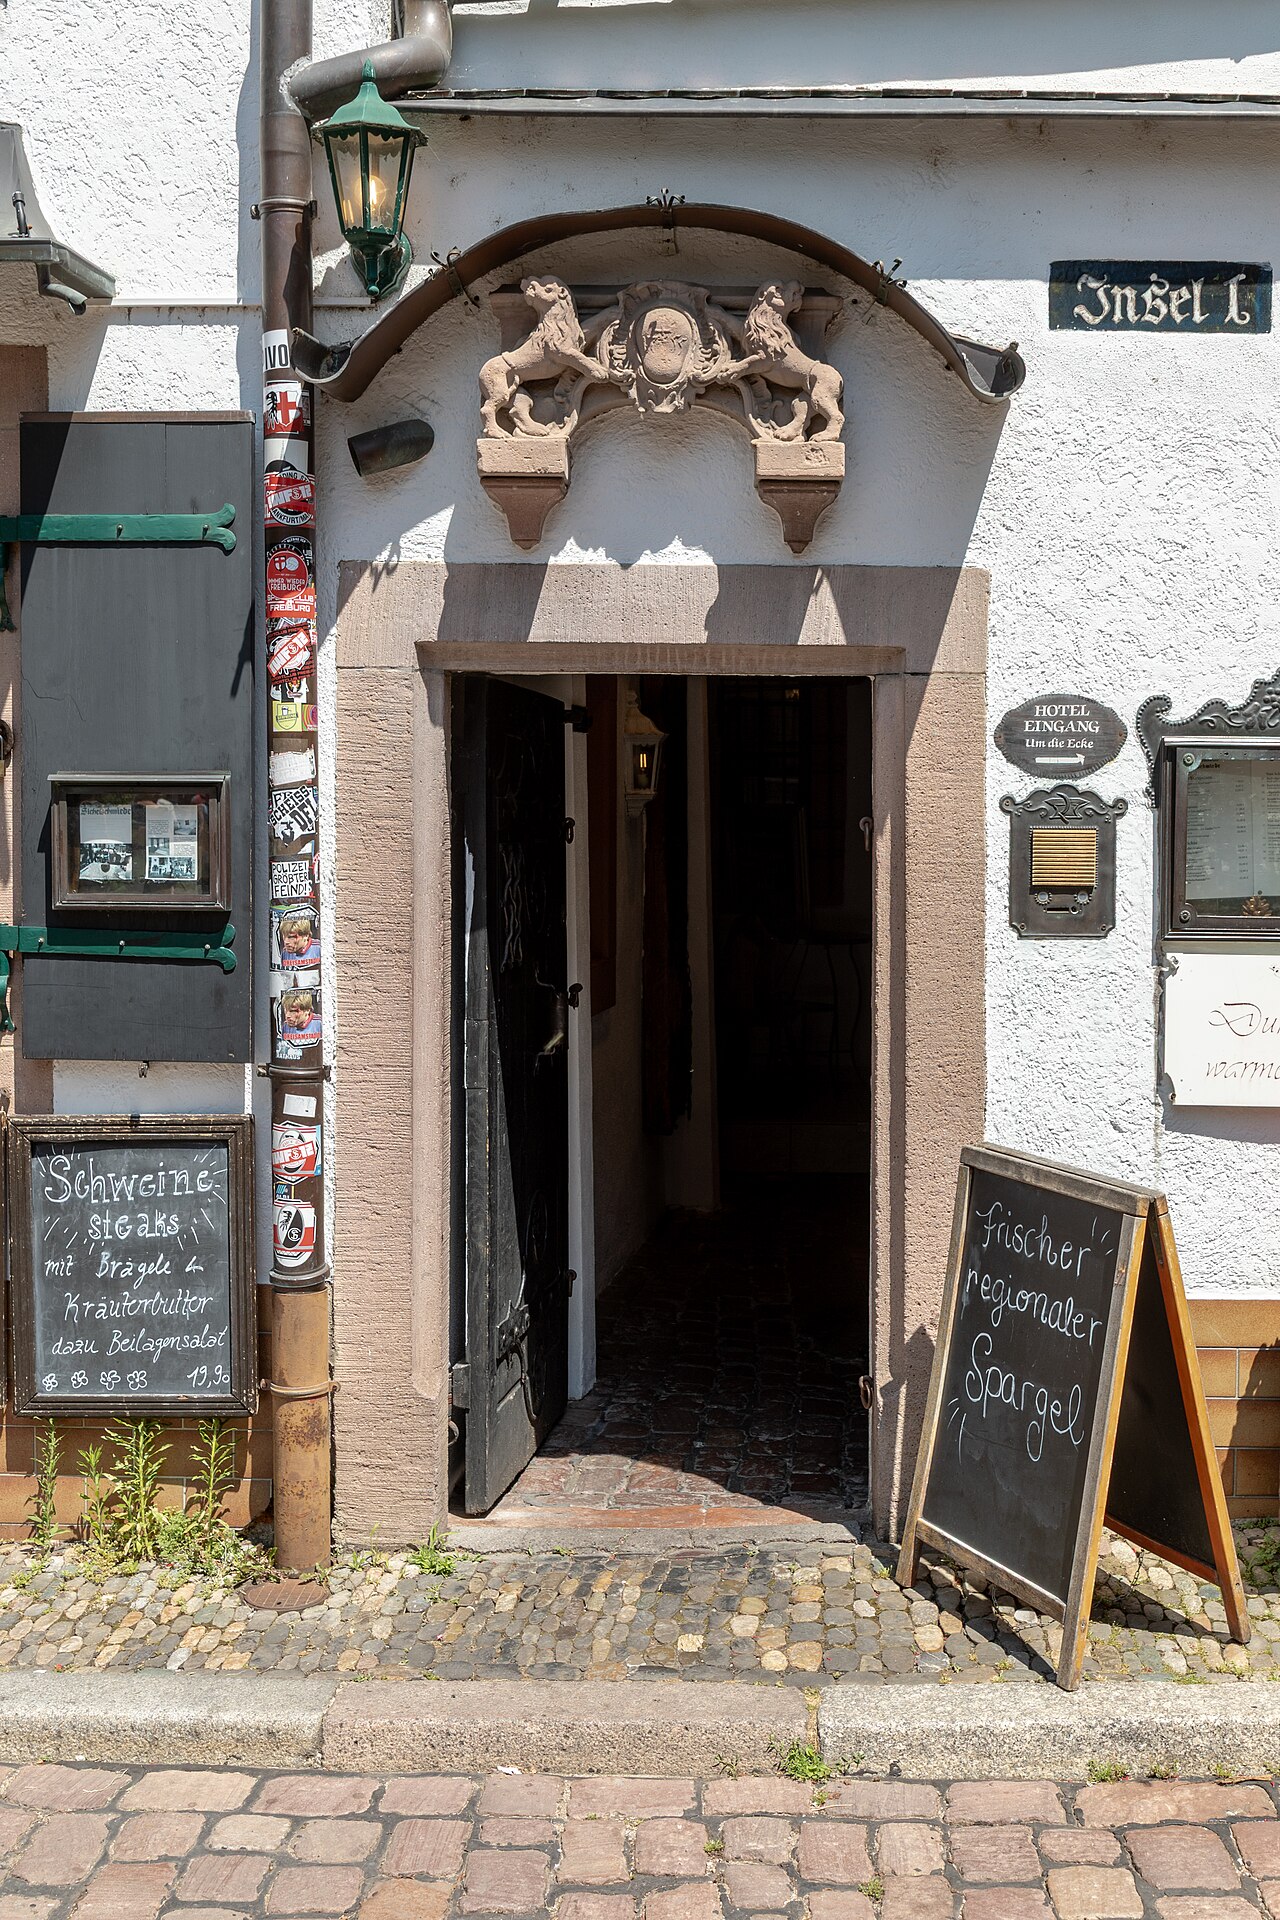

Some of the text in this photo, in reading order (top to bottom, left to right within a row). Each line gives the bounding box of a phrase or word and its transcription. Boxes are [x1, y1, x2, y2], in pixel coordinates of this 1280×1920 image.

[1073, 273, 1210, 325] Insel
[269, 604, 311, 612] FREIBURG
[1034, 704, 1090, 717] HOTEL
[1023, 720, 1100, 734] EINGANG
[1025, 738, 1094, 749] Um die Ecke
[270, 785, 310, 826] SCHEISS
[272, 862, 307, 873] POLIZEI
[274, 883, 307, 897] FEIND!
[1208, 1003, 1280, 1036] Du
[44, 1154, 214, 1204] Schweine
[88, 1209, 180, 1240] steaks
[45, 1255, 74, 1277] mit
[64, 1288, 214, 1323] Kräuterbutter
[966, 1267, 1103, 1346] regionaler
[52, 1323, 228, 1363] dazu Beilagensalat
[186, 1365, 231, 1388] 19,90
[965, 1332, 1085, 1462] Spargel
